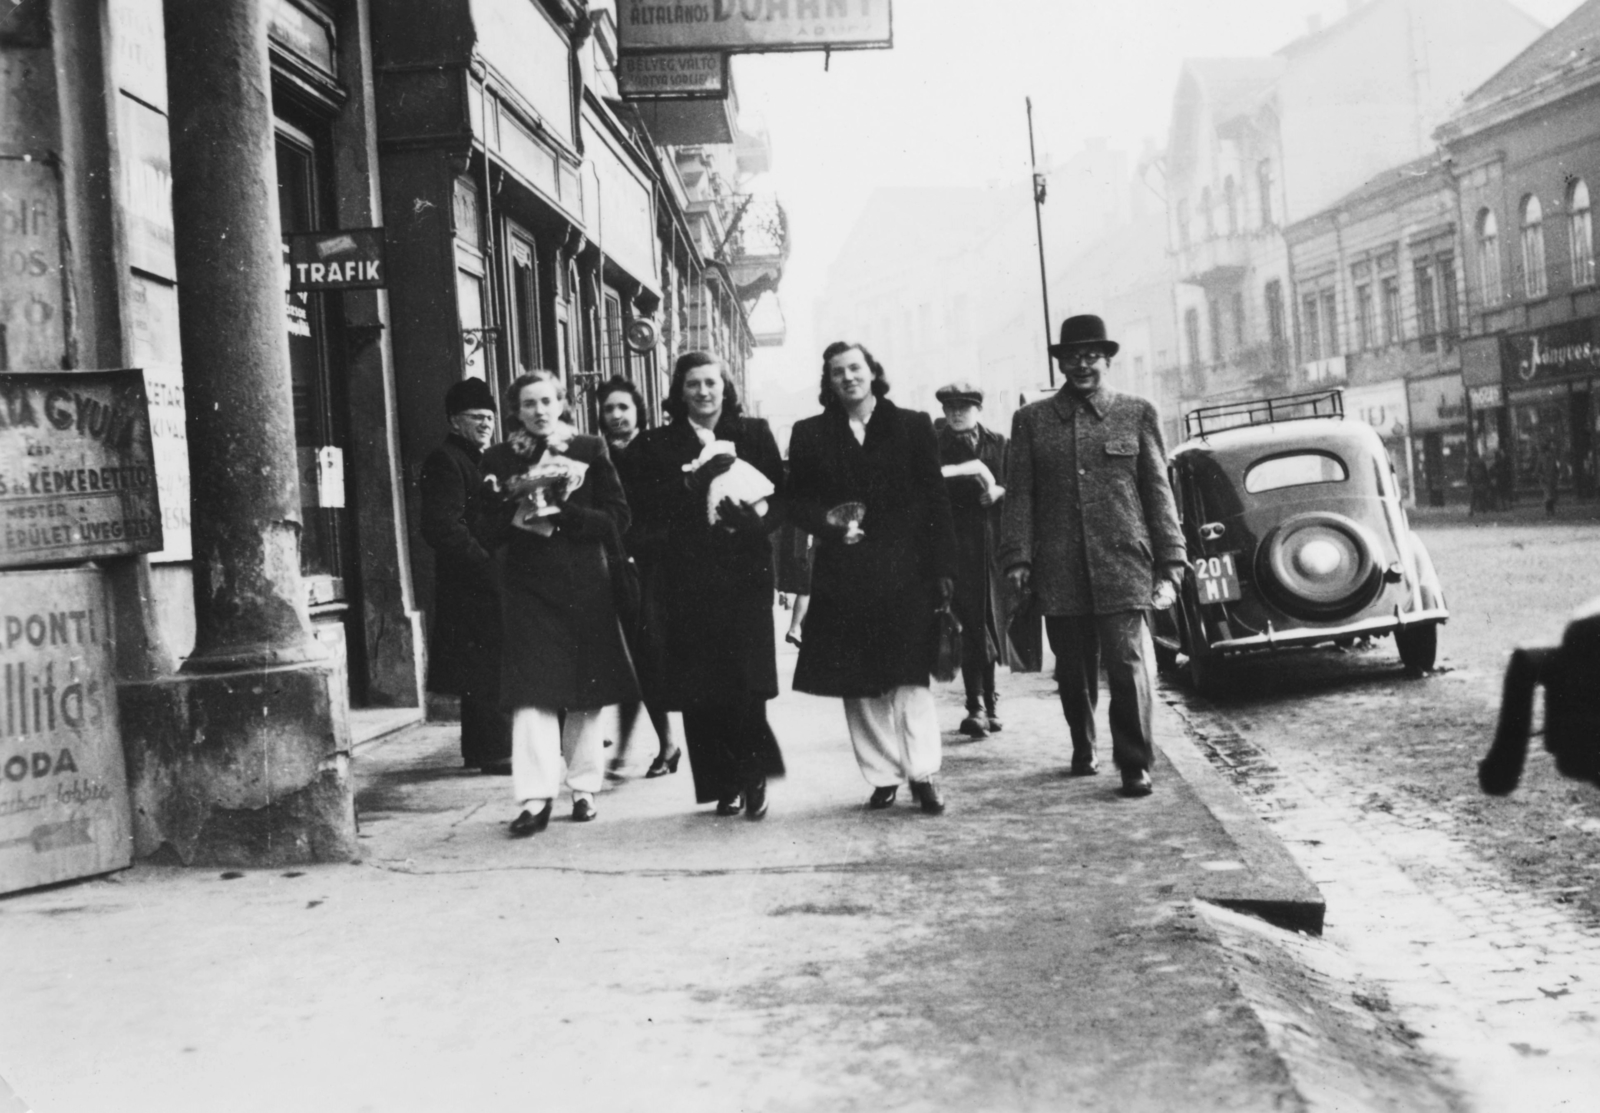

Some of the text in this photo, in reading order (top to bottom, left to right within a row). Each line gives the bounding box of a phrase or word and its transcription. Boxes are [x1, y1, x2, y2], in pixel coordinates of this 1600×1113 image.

[296, 260, 380, 283] TRAFIK
[1196, 555, 1233, 579] 201
[0, 608, 97, 649] PONTI
[0, 748, 79, 782] ODA
